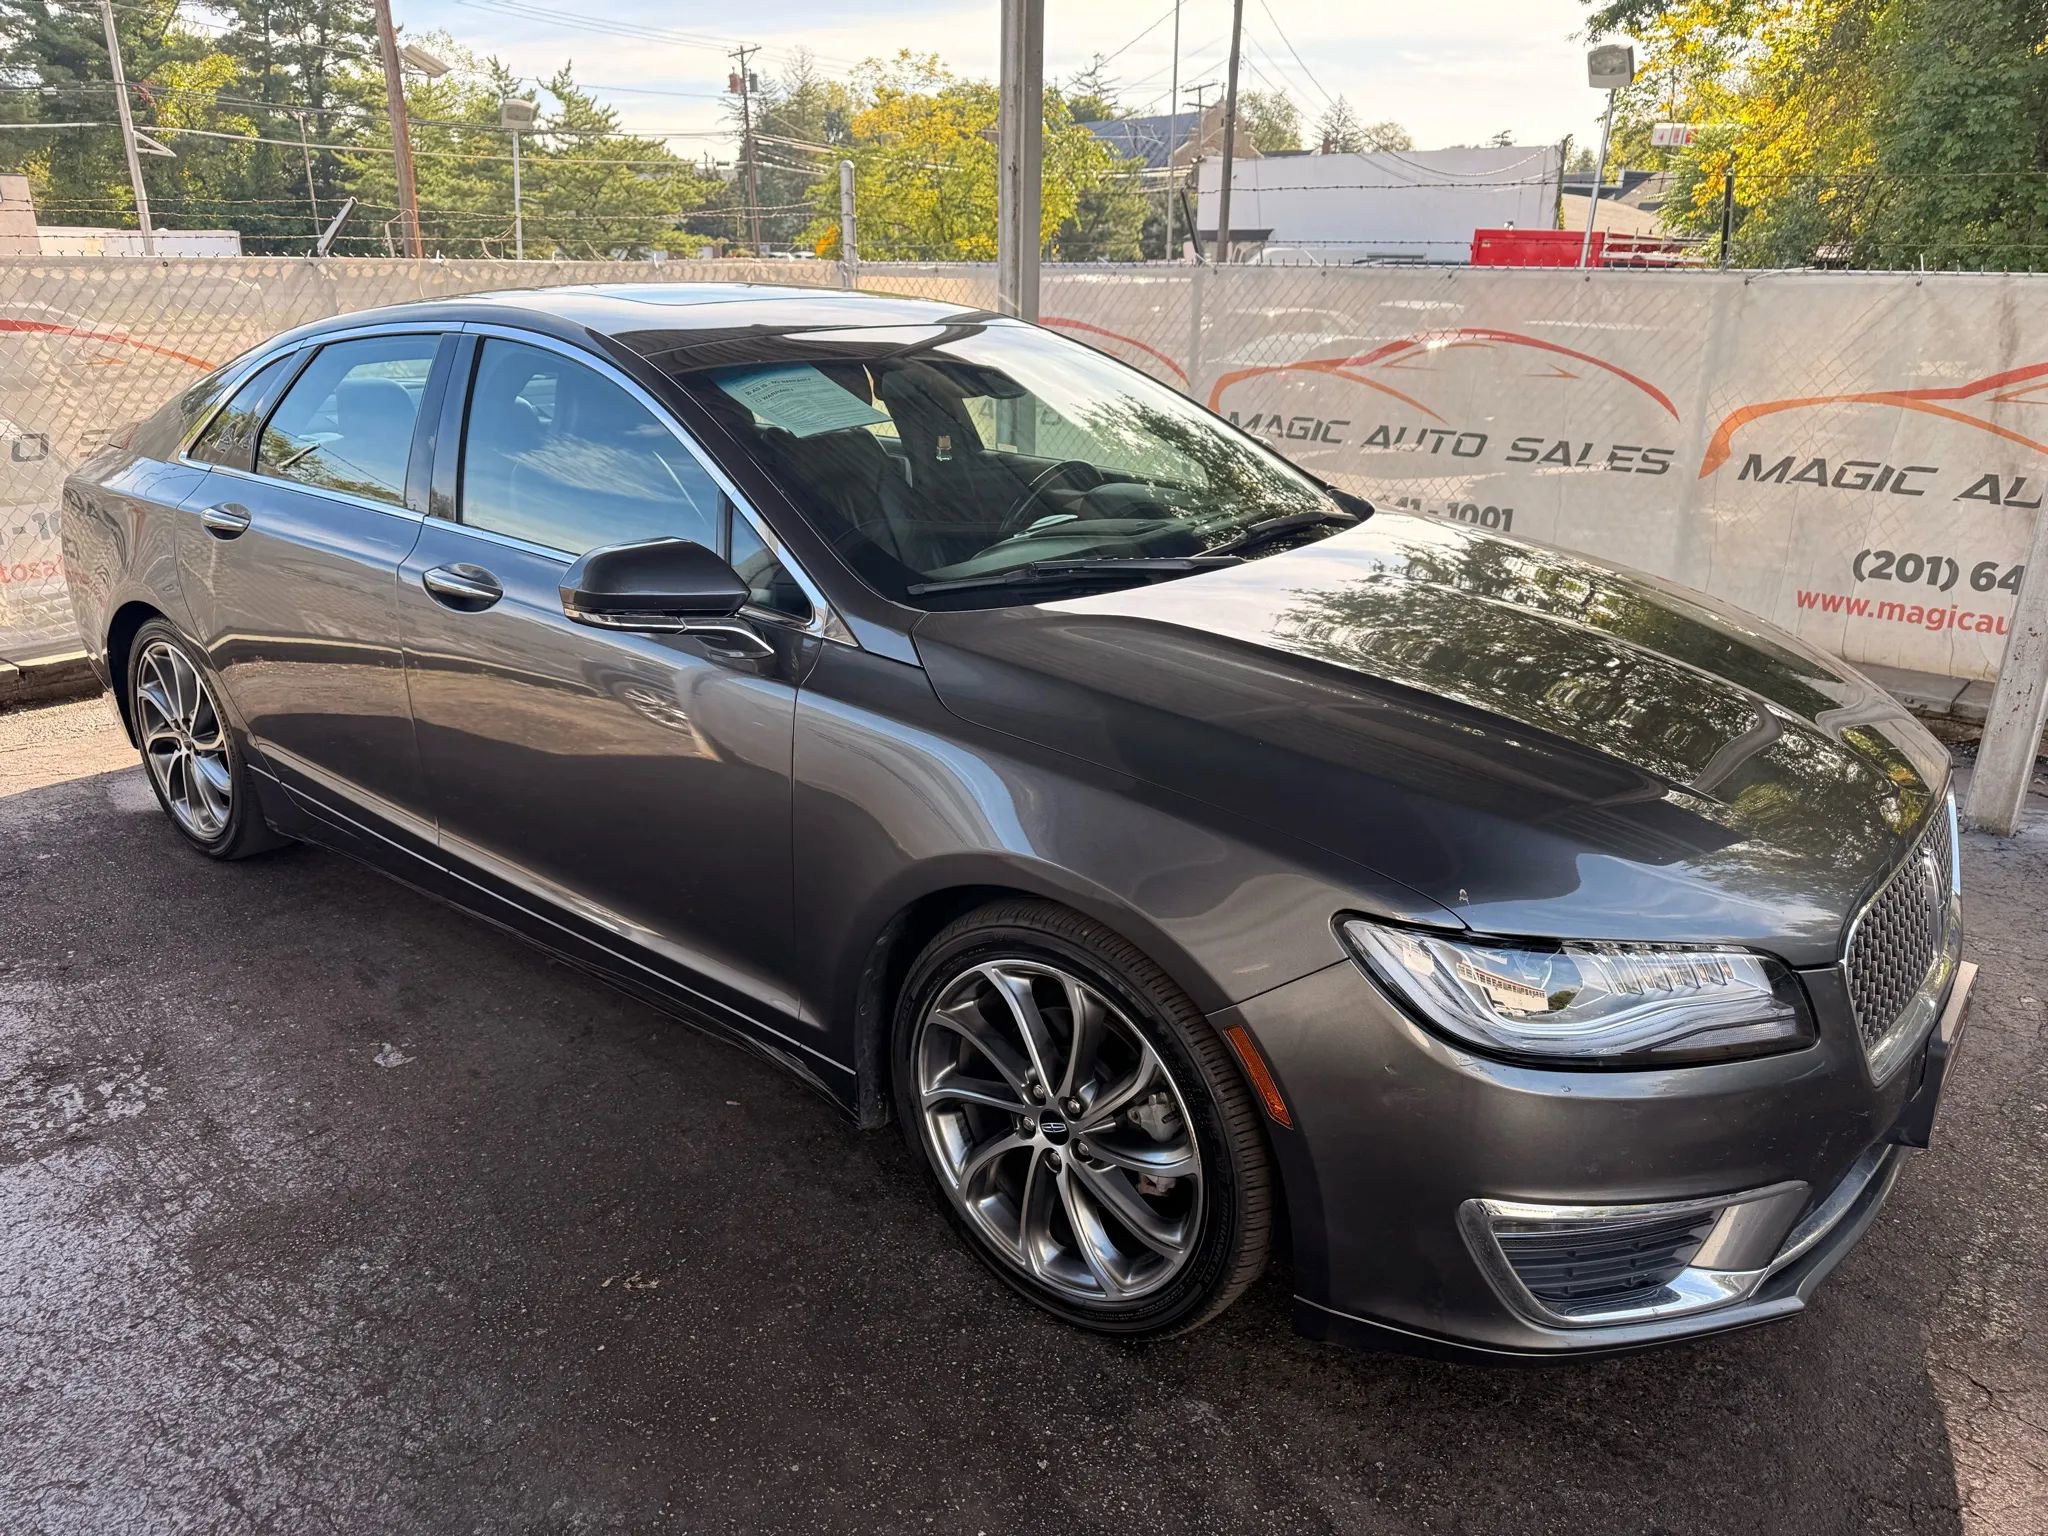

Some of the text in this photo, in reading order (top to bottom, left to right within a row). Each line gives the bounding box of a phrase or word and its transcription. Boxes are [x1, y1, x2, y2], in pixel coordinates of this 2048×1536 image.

[1228, 411, 1676, 475] MAGIC AUTO SALES
[1737, 454, 1940, 497] MAGIC
[1447, 502, 1514, 532] 1001
[1852, 548, 2026, 596] (201) 64
